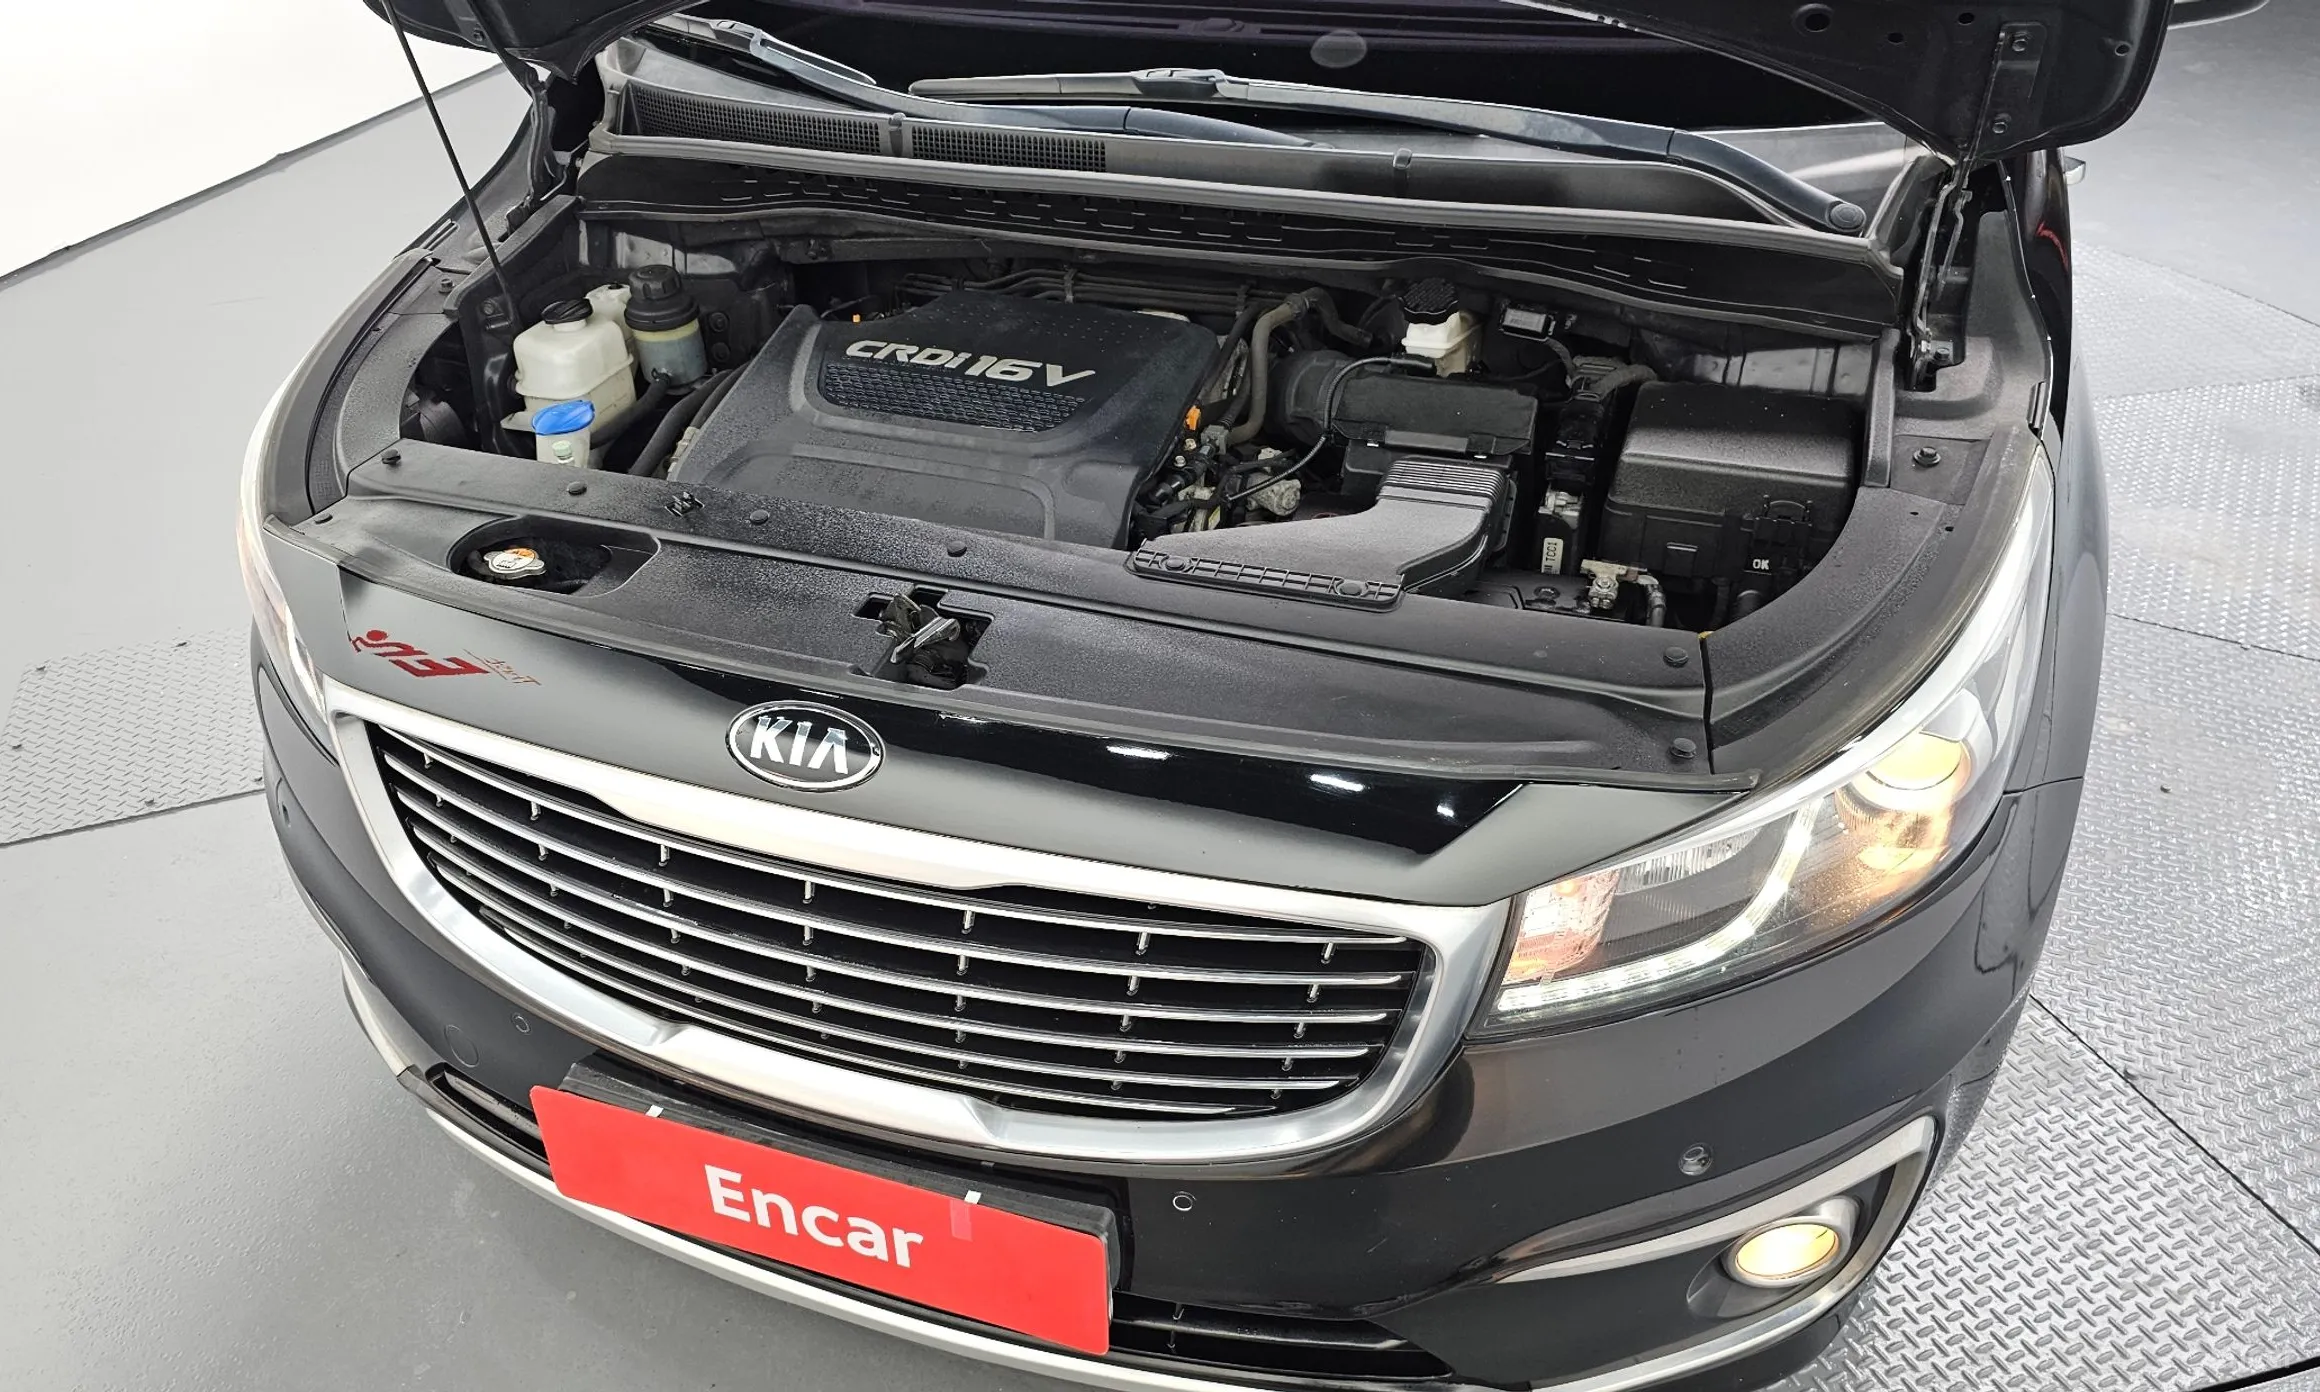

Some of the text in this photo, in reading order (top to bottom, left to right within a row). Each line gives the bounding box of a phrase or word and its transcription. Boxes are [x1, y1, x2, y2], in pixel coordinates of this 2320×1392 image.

[1752, 558, 1770, 570] OK
[750, 715, 849, 775] KIA
[704, 1164, 924, 1268] Encar
